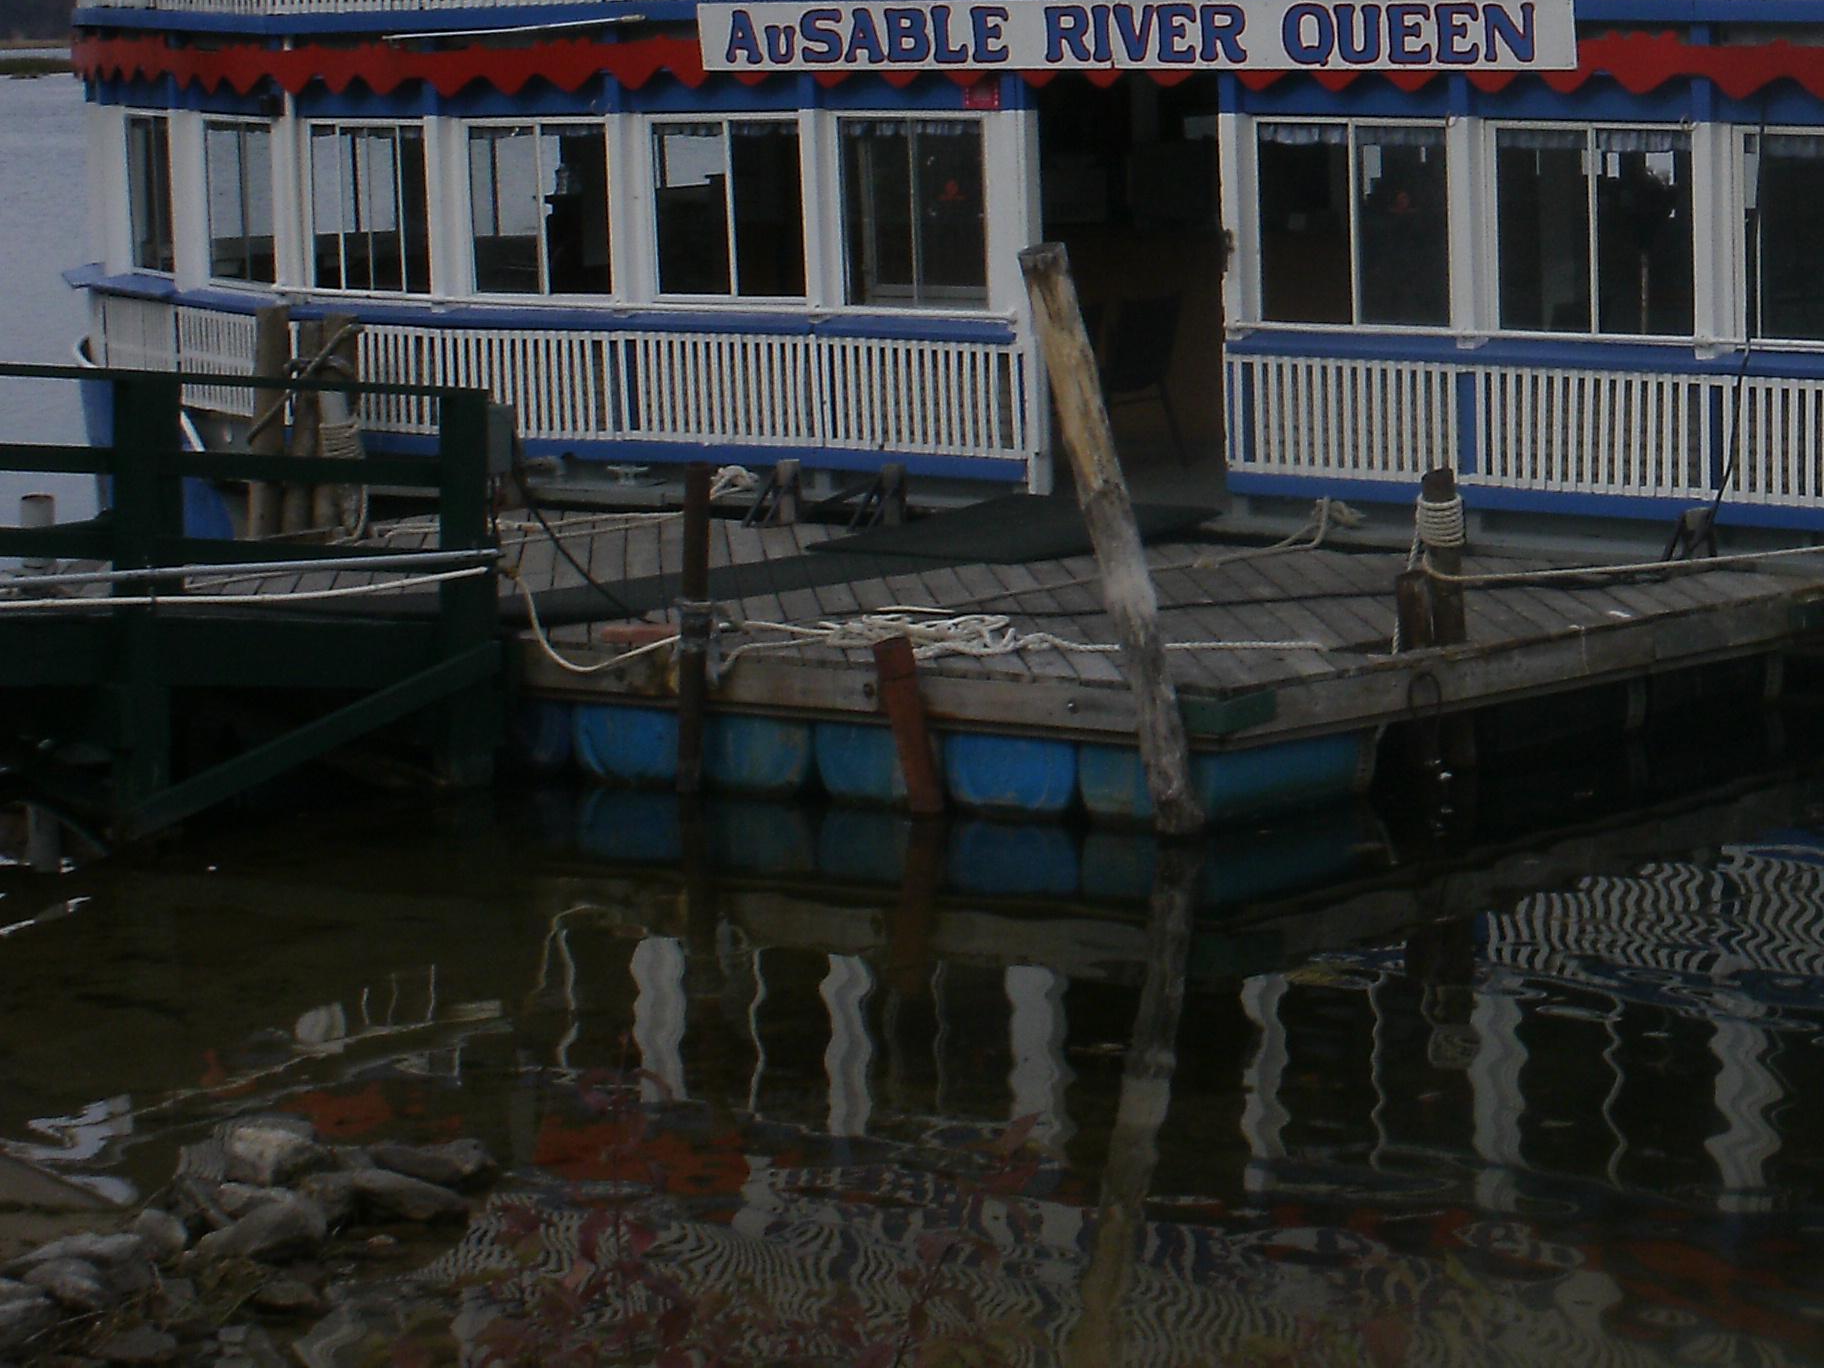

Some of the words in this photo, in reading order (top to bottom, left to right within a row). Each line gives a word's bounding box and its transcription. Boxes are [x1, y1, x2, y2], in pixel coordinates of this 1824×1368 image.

[725, 4, 1009, 65] AuSABLE
[1045, 3, 1247, 64] RIVER
[1282, 2, 1535, 67] QUEEN
